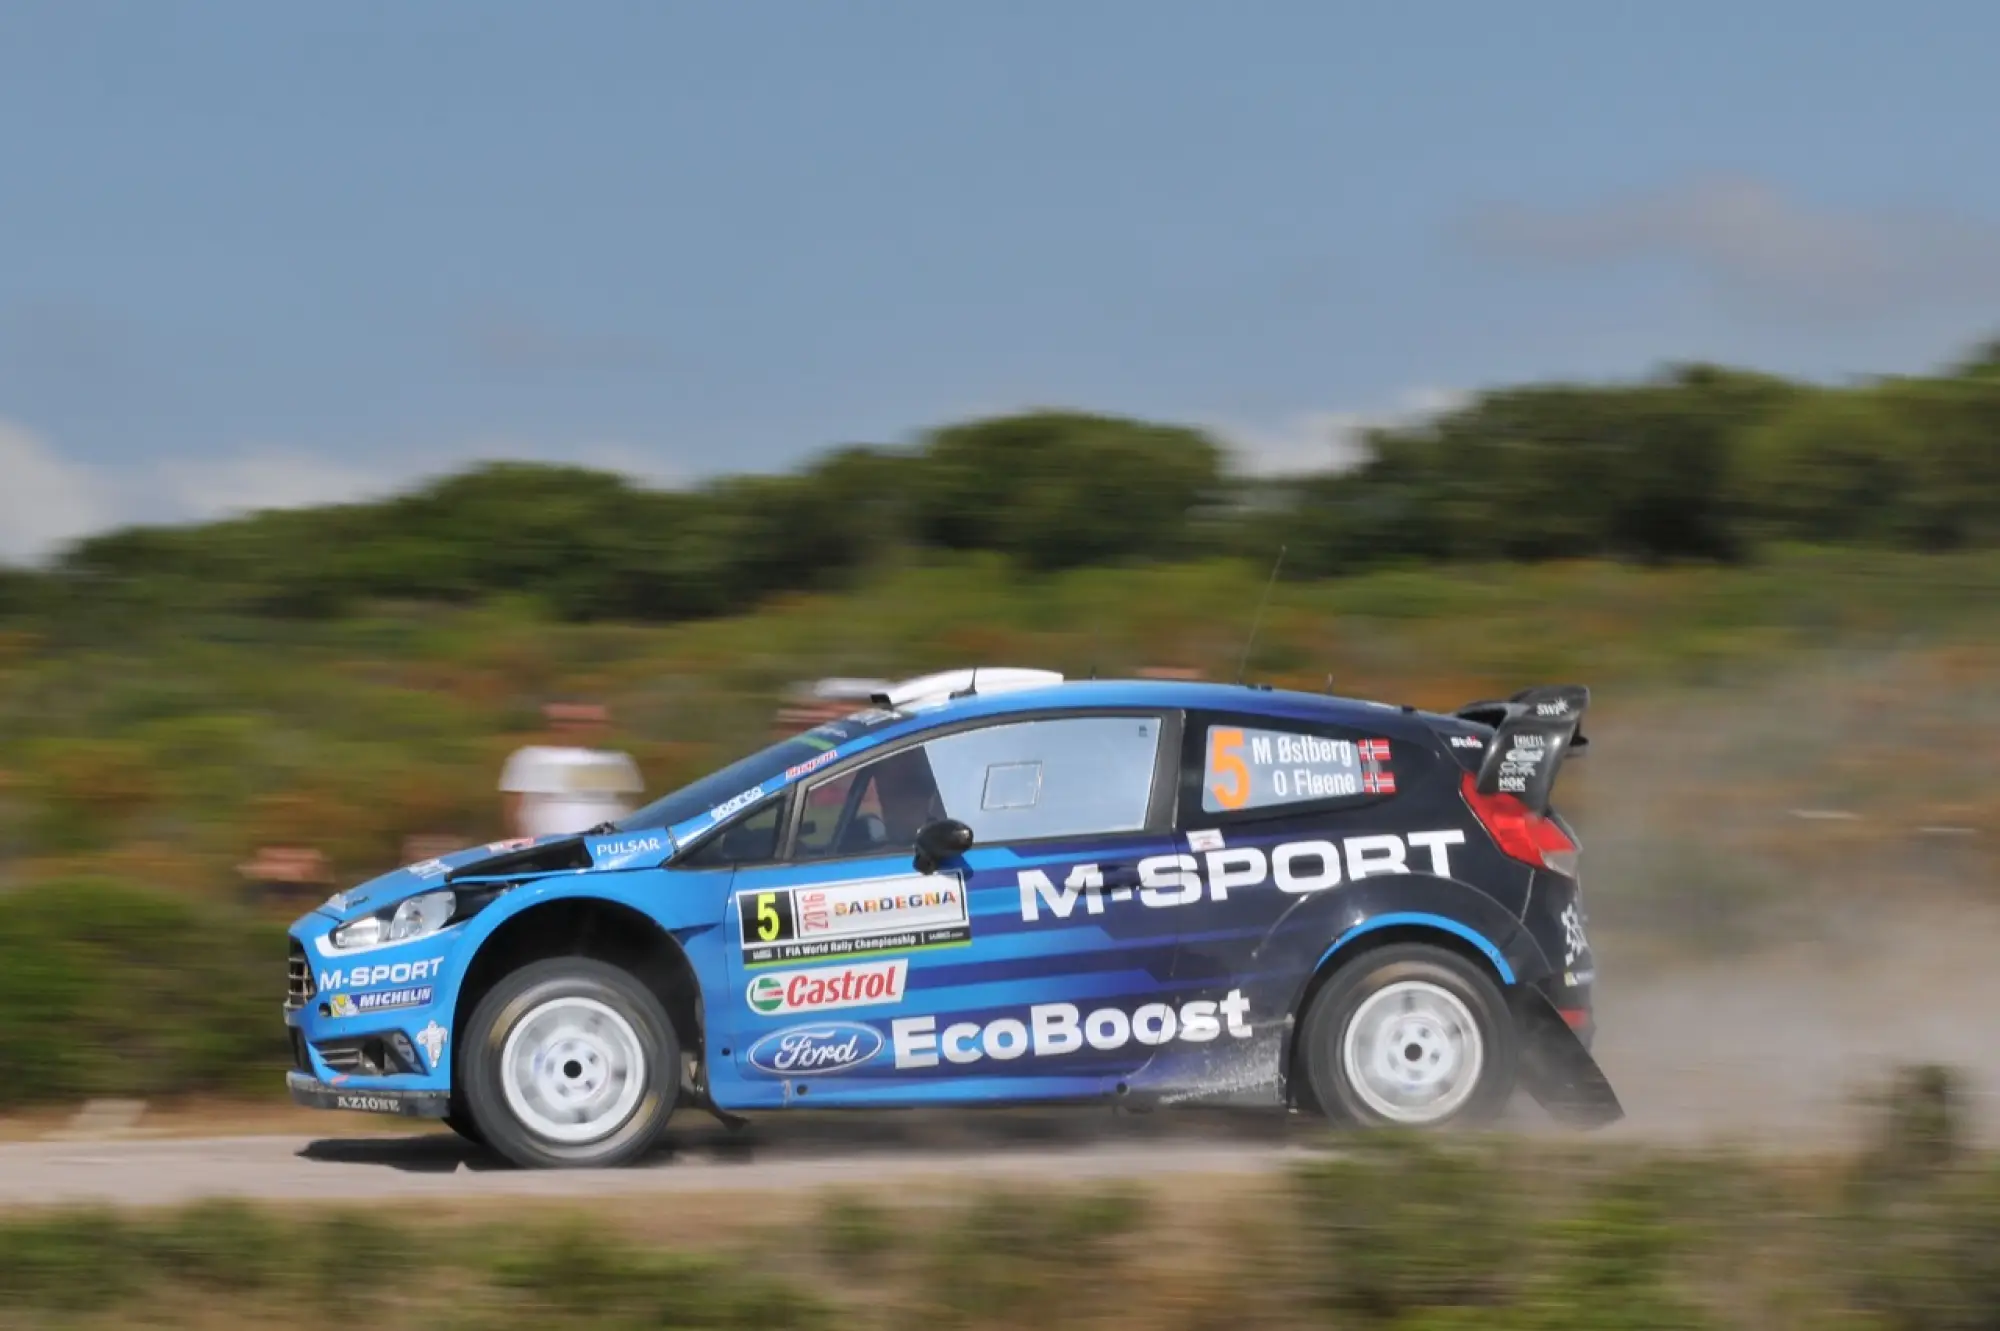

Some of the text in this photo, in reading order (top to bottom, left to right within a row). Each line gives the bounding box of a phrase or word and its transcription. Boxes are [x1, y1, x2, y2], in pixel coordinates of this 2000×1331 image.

[1211, 729, 1251, 810] 5
[1251, 734, 1352, 767] M Østberg
[1273, 769, 1356, 796] O Fløene
[596, 837, 660, 857] PULSAR
[1017, 830, 1466, 922] M-SPORT
[757, 891, 780, 942] 5
[803, 891, 829, 932] 2016
[834, 891, 957, 917] SARDEGNA
[785, 945, 801, 957] FIA
[802, 942, 829, 955] World
[830, 940, 853, 953] Rally
[855, 933, 917, 949] Championship
[320, 956, 445, 992] M-SPORT
[787, 966, 896, 1008] Castrol
[360, 987, 432, 1008] MICHELIN
[891, 988, 1253, 1069] EcoBoost
[774, 1029, 858, 1069] Ford
